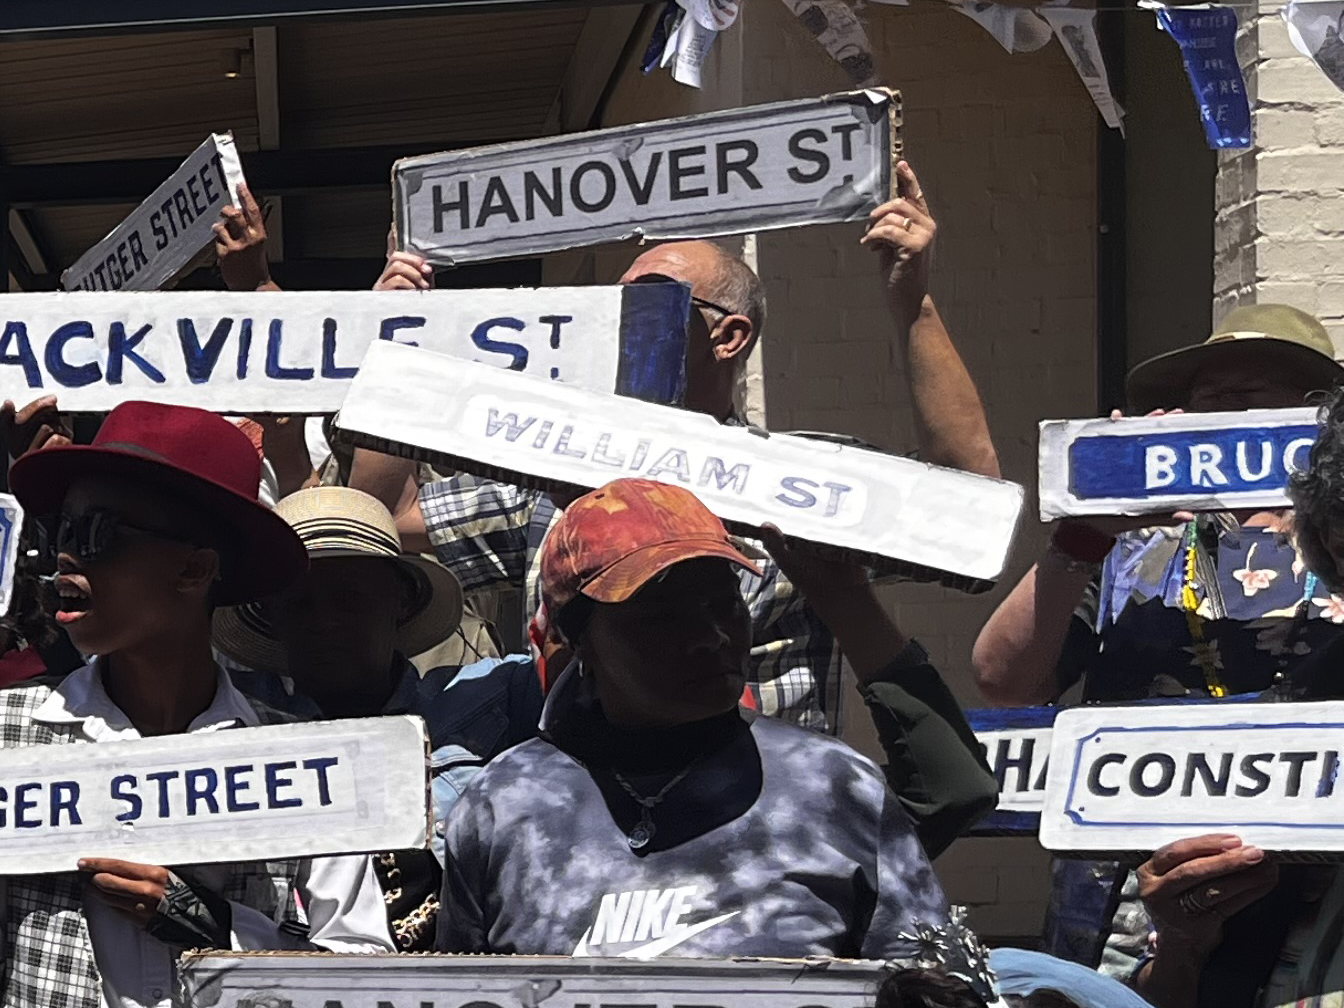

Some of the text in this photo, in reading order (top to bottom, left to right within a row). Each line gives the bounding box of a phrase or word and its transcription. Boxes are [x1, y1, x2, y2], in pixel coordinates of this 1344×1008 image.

[431, 138, 762, 234] HANOVER
[72, 152, 229, 291] UTGER STREET
[485, 407, 852, 518] WILLIAM ST
[1145, 437, 1317, 490] BRUC
[111, 756, 339, 821] STREET
[1087, 751, 1339, 798] CONSTI
[591, 884, 701, 947] NIKE
